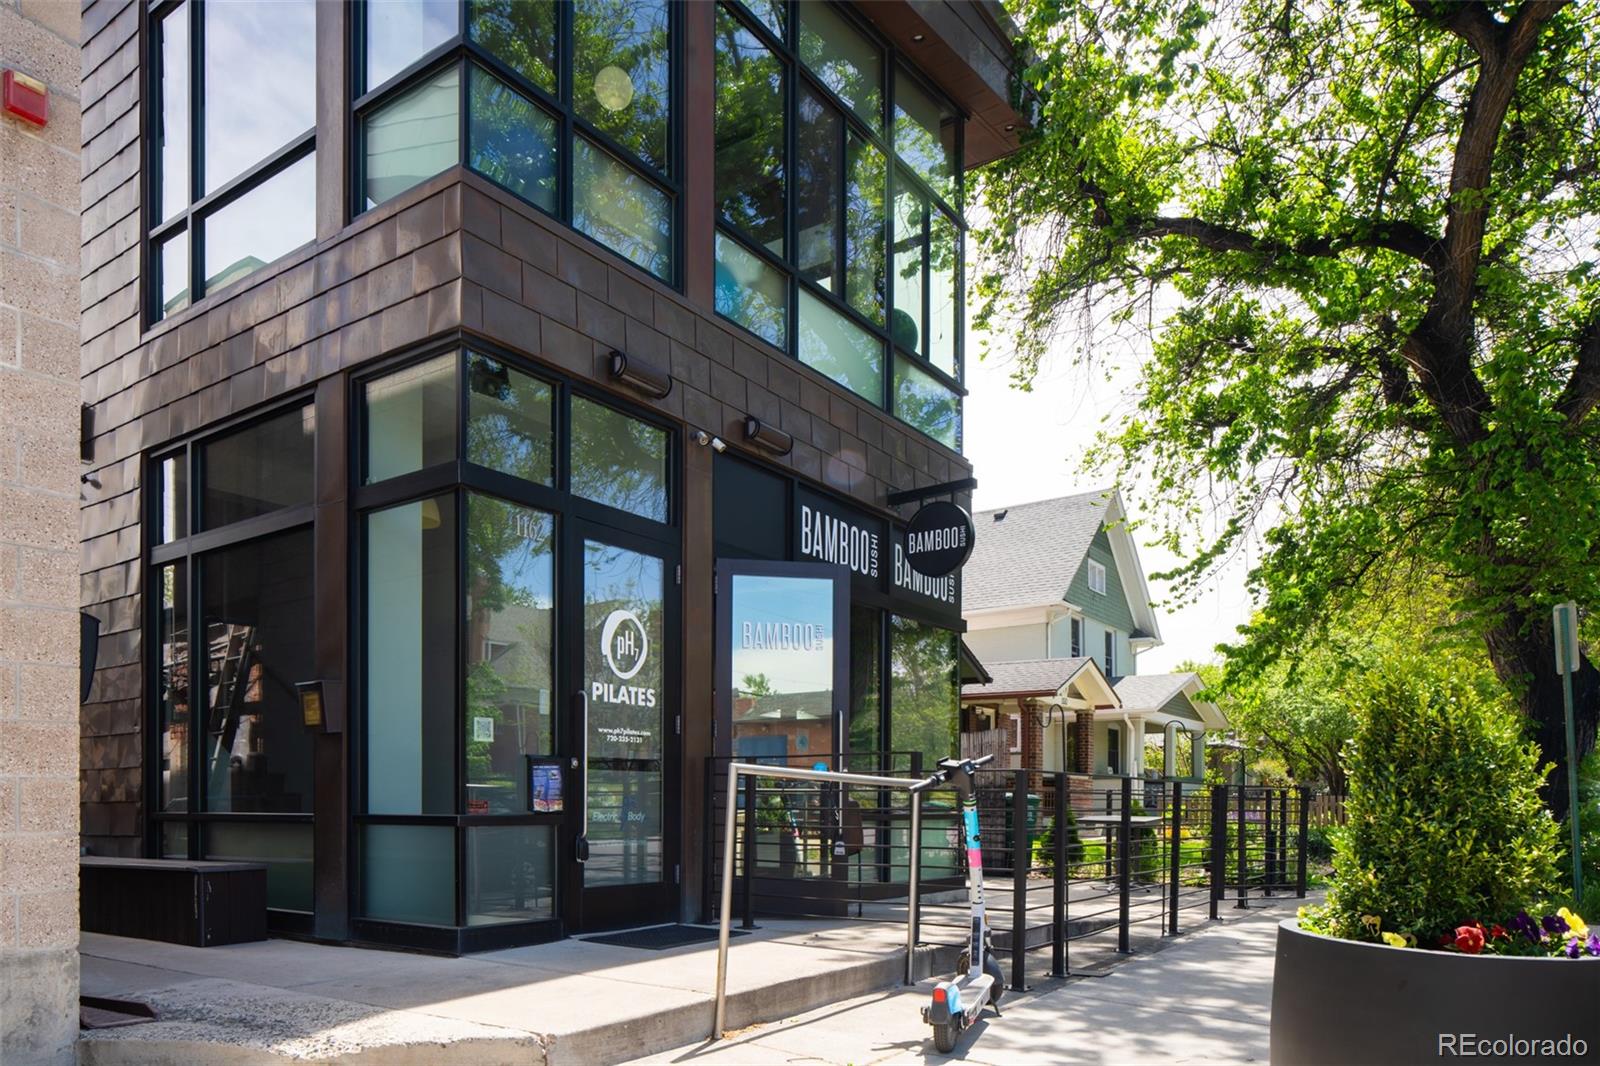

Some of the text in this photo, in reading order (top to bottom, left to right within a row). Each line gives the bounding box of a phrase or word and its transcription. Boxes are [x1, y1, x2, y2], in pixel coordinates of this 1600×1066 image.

[801, 505, 879, 578] BAMBOO SUSHI
[908, 526, 959, 554] BAMBOO
[742, 622, 824, 651] BAMBOO SUSHI
[592, 681, 656, 708] PILATES
